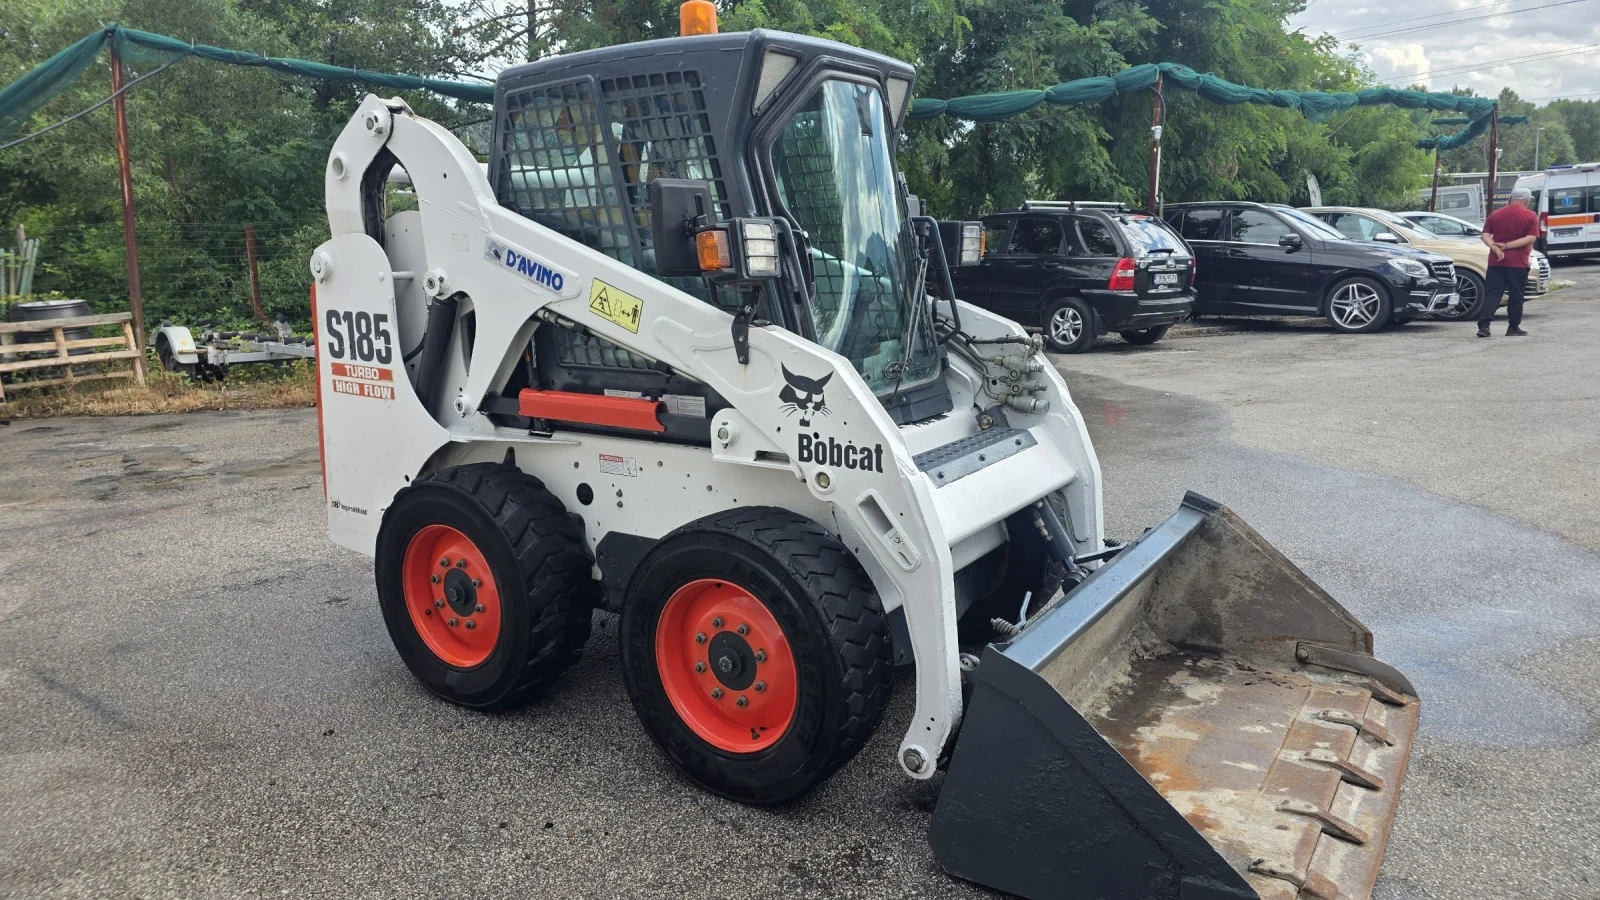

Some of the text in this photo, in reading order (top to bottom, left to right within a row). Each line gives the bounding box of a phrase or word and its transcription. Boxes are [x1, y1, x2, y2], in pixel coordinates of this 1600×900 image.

[326, 309, 392, 364] S185
[344, 365, 379, 379] TURBO
[335, 380, 392, 399] HIGH FLOW
[798, 433, 883, 473] Bobcat
